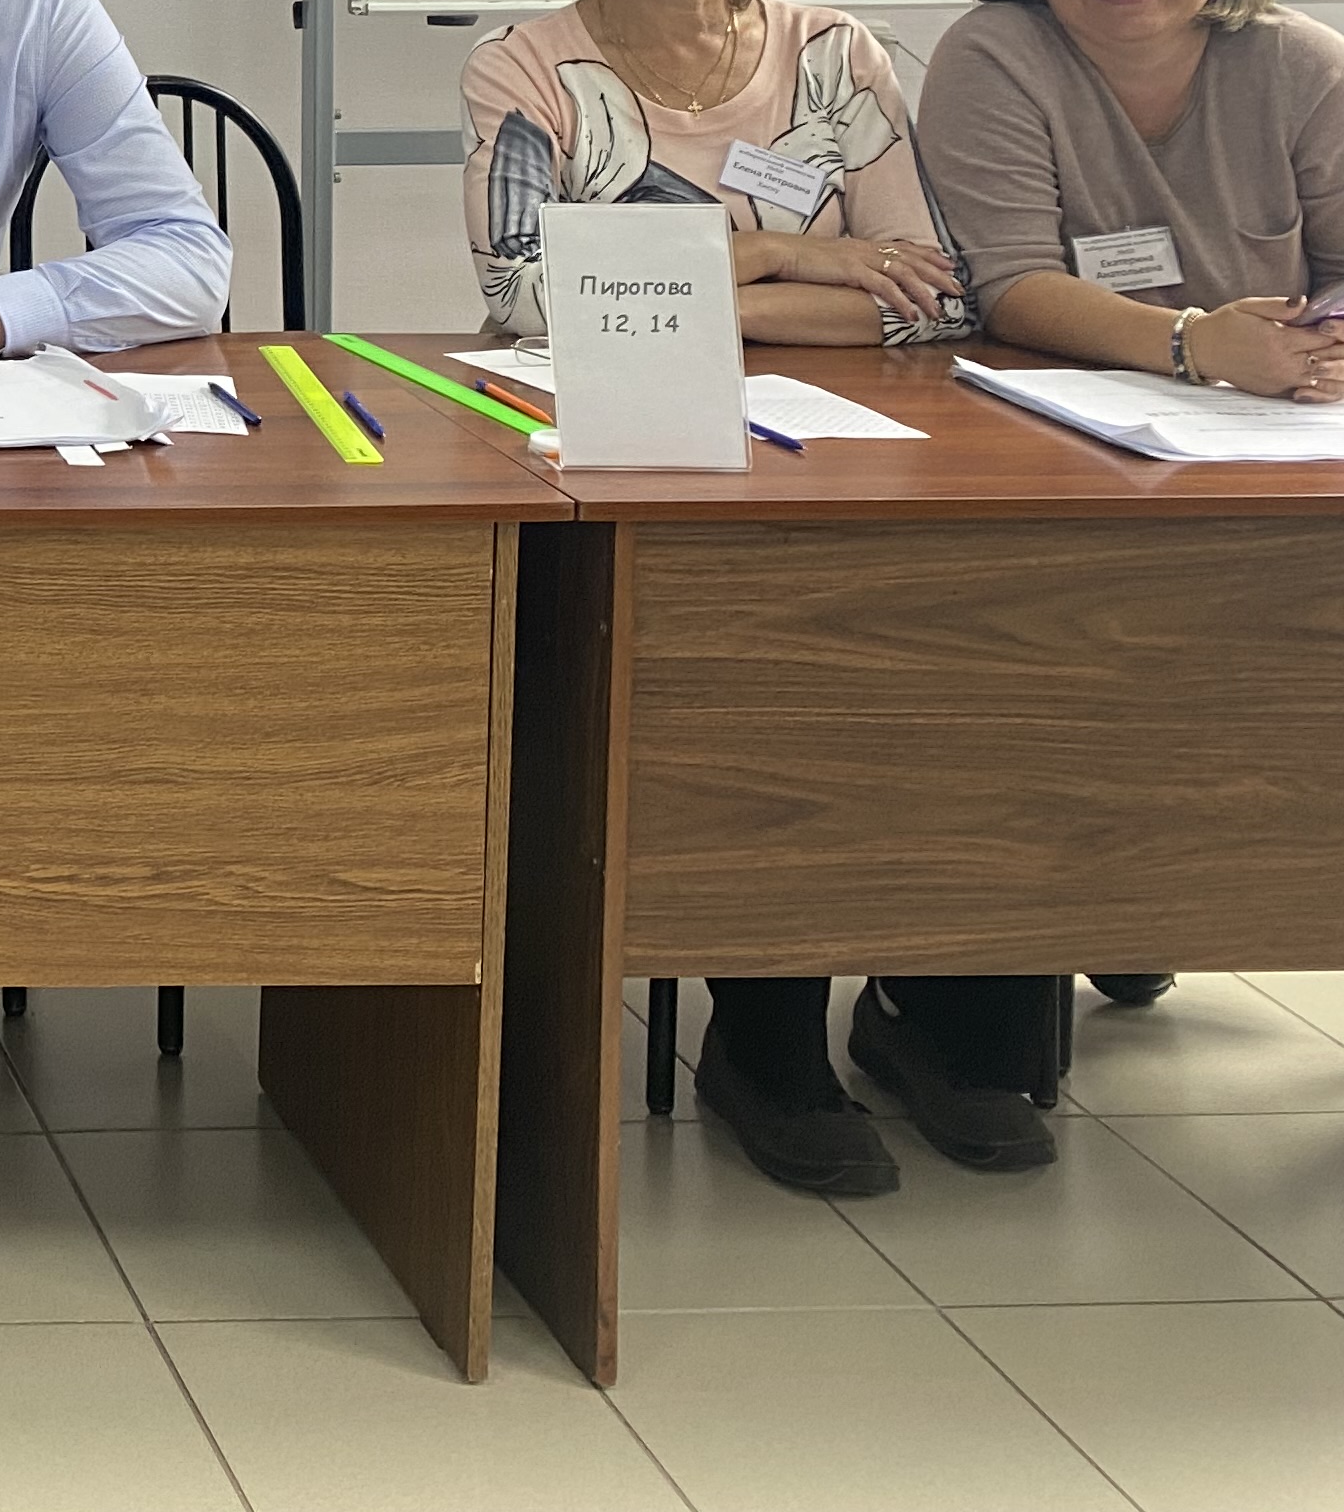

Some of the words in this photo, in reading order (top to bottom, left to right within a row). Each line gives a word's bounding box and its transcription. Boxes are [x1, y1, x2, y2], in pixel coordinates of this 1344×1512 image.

[579, 275, 693, 301] Пирогова
[600, 313, 637, 336] 12,
[650, 313, 680, 333] 14
